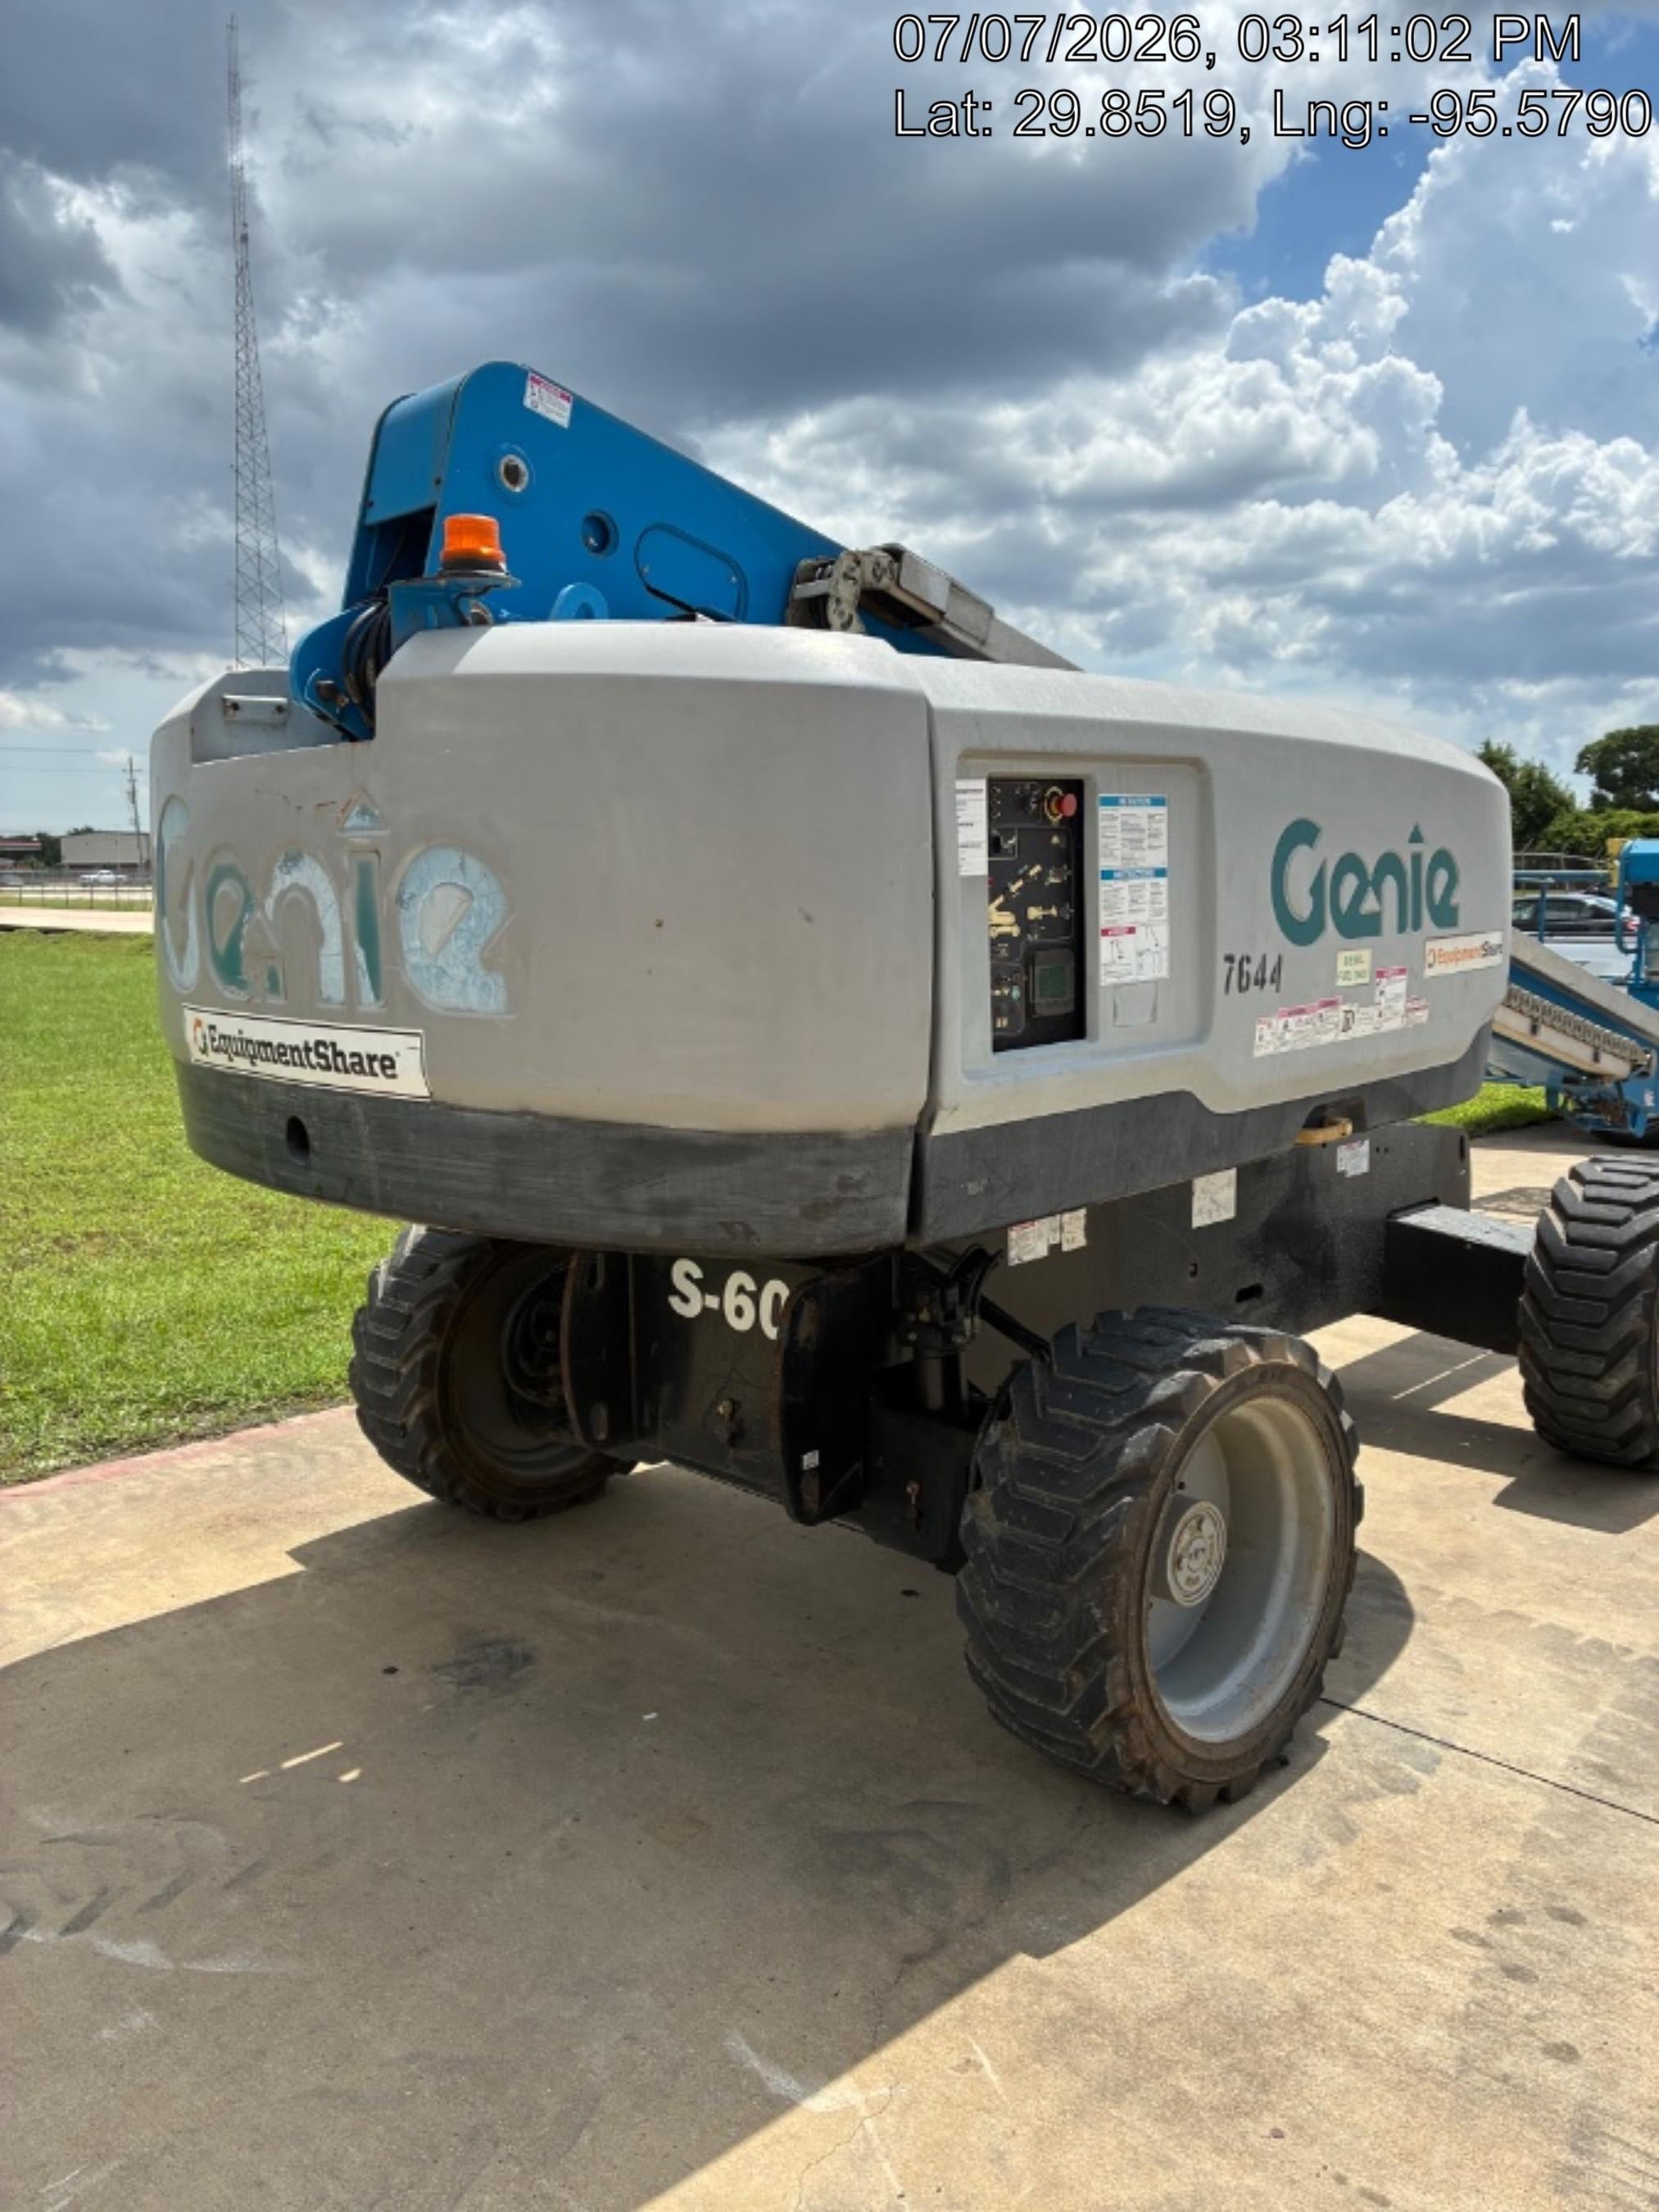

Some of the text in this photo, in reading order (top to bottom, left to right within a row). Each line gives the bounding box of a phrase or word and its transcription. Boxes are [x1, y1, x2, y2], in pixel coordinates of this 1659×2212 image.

[1271, 818, 1459, 946] Genie
[1223, 953, 1283, 995] 7644
[207, 1024, 398, 1079] EquipmentShare
[668, 1258, 790, 1340] S-60
